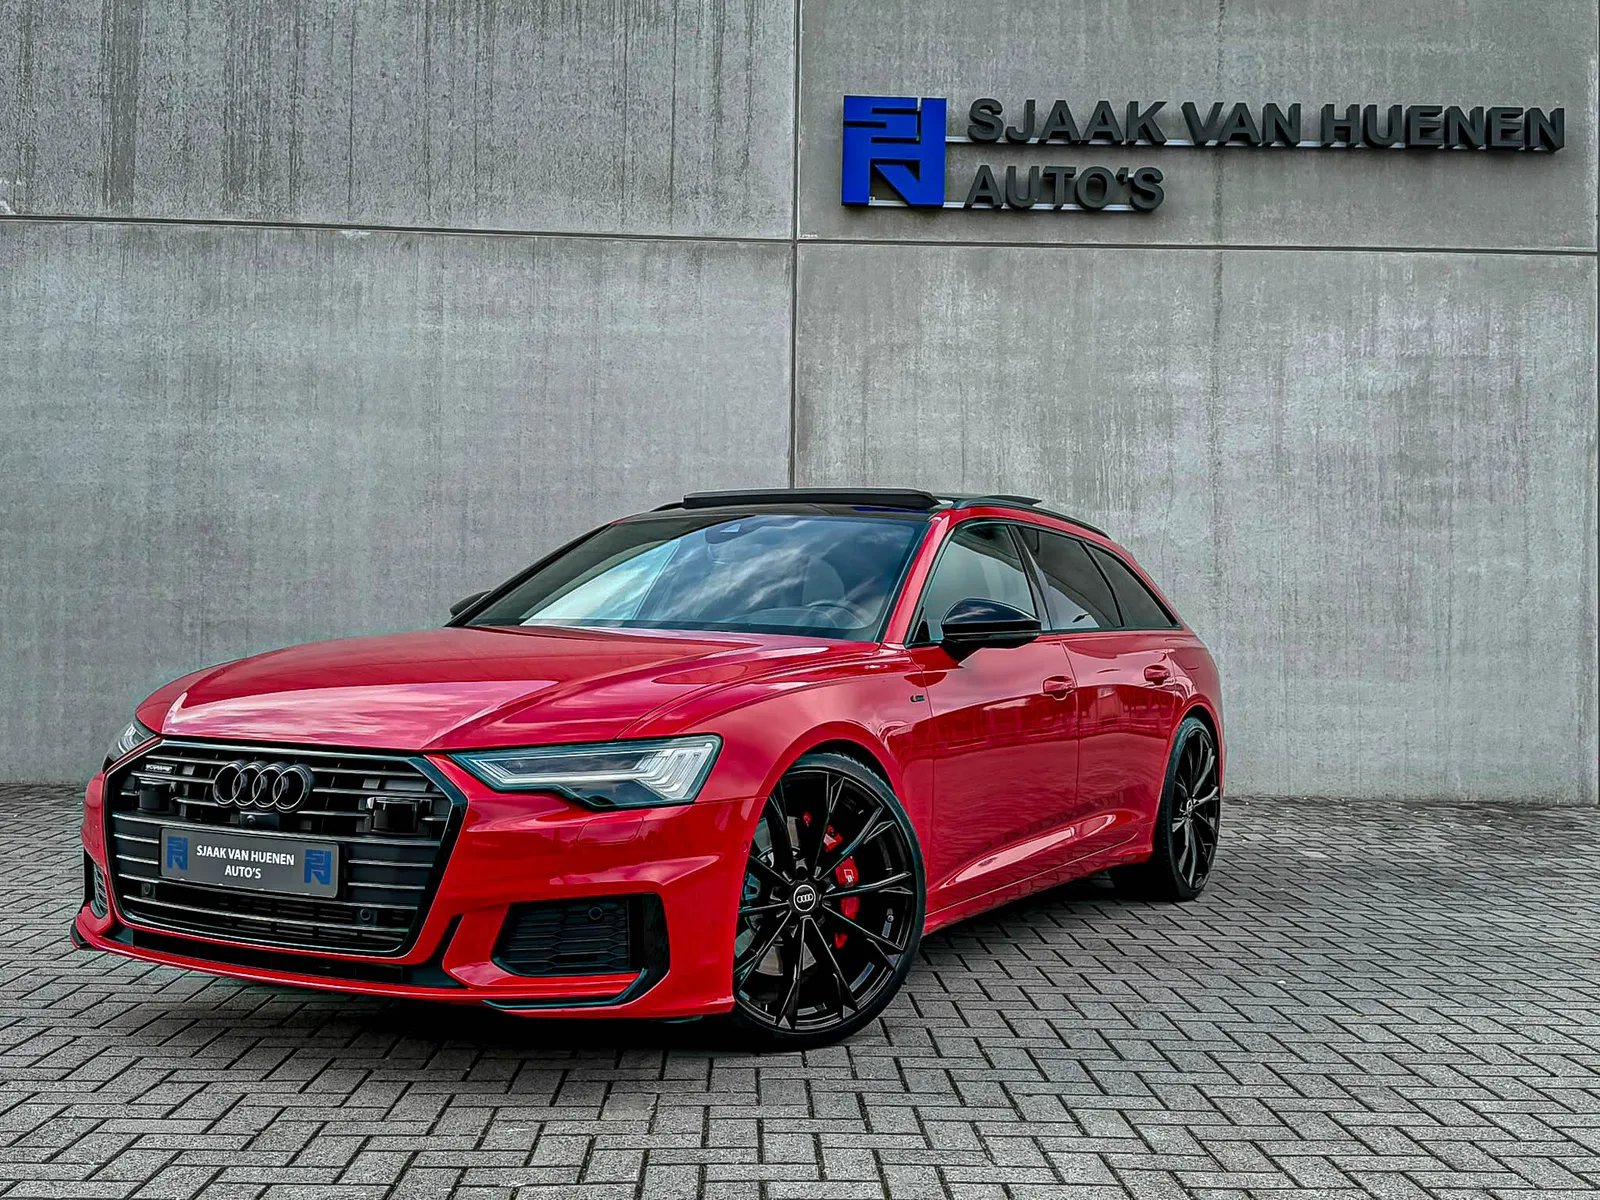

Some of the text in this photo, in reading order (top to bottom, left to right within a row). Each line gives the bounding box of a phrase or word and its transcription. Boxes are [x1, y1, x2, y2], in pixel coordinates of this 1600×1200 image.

[966, 97, 1566, 153] SJAAK VAN HUENEN
[964, 164, 1165, 212] AUTO'S
[196, 844, 227, 859] SJAAK
[228, 848, 249, 861] VAN
[250, 850, 295, 866] HUENEN
[224, 864, 262, 879] AUTO'S
